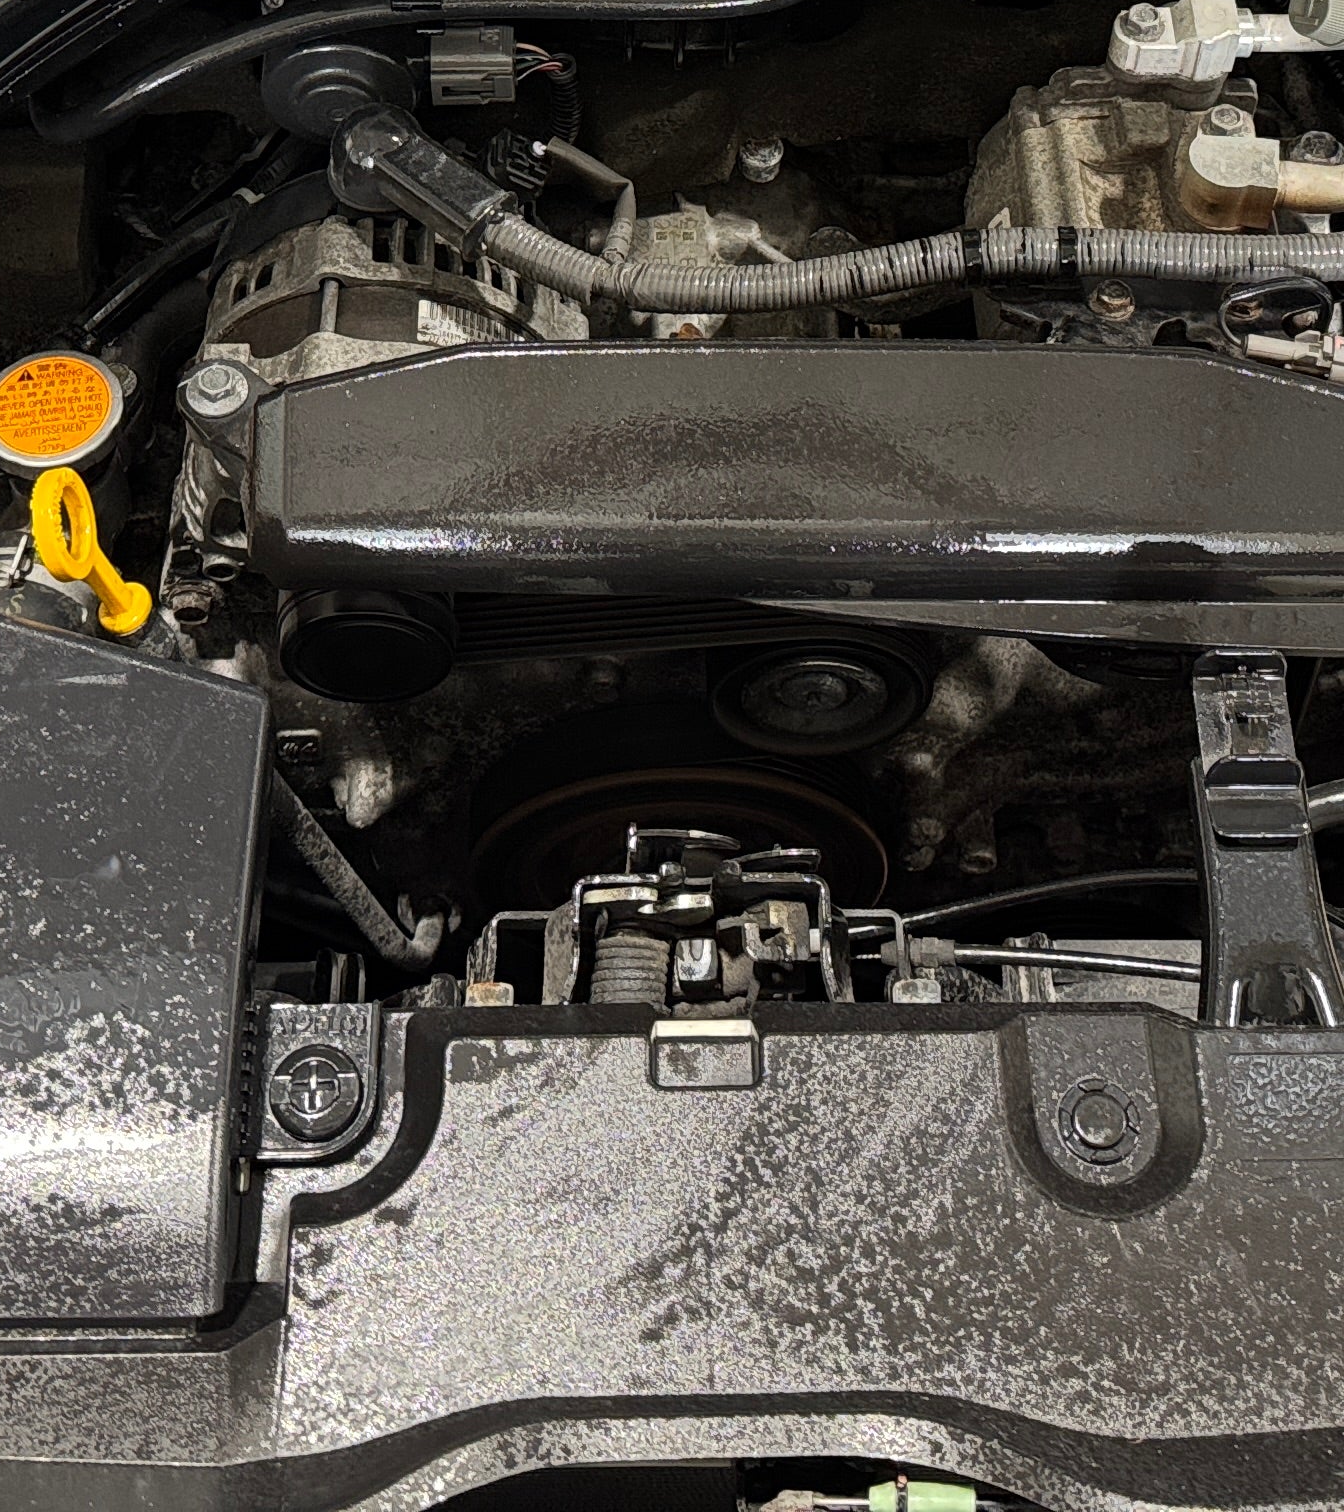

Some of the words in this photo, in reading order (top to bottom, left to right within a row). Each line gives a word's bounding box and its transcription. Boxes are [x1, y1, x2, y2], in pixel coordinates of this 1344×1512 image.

[36, 369, 83, 380] WARNING
[29, 398, 51, 409] OPEN
[54, 395, 81, 406] WHEN
[13, 422, 87, 438] AVERTISSEMENT
